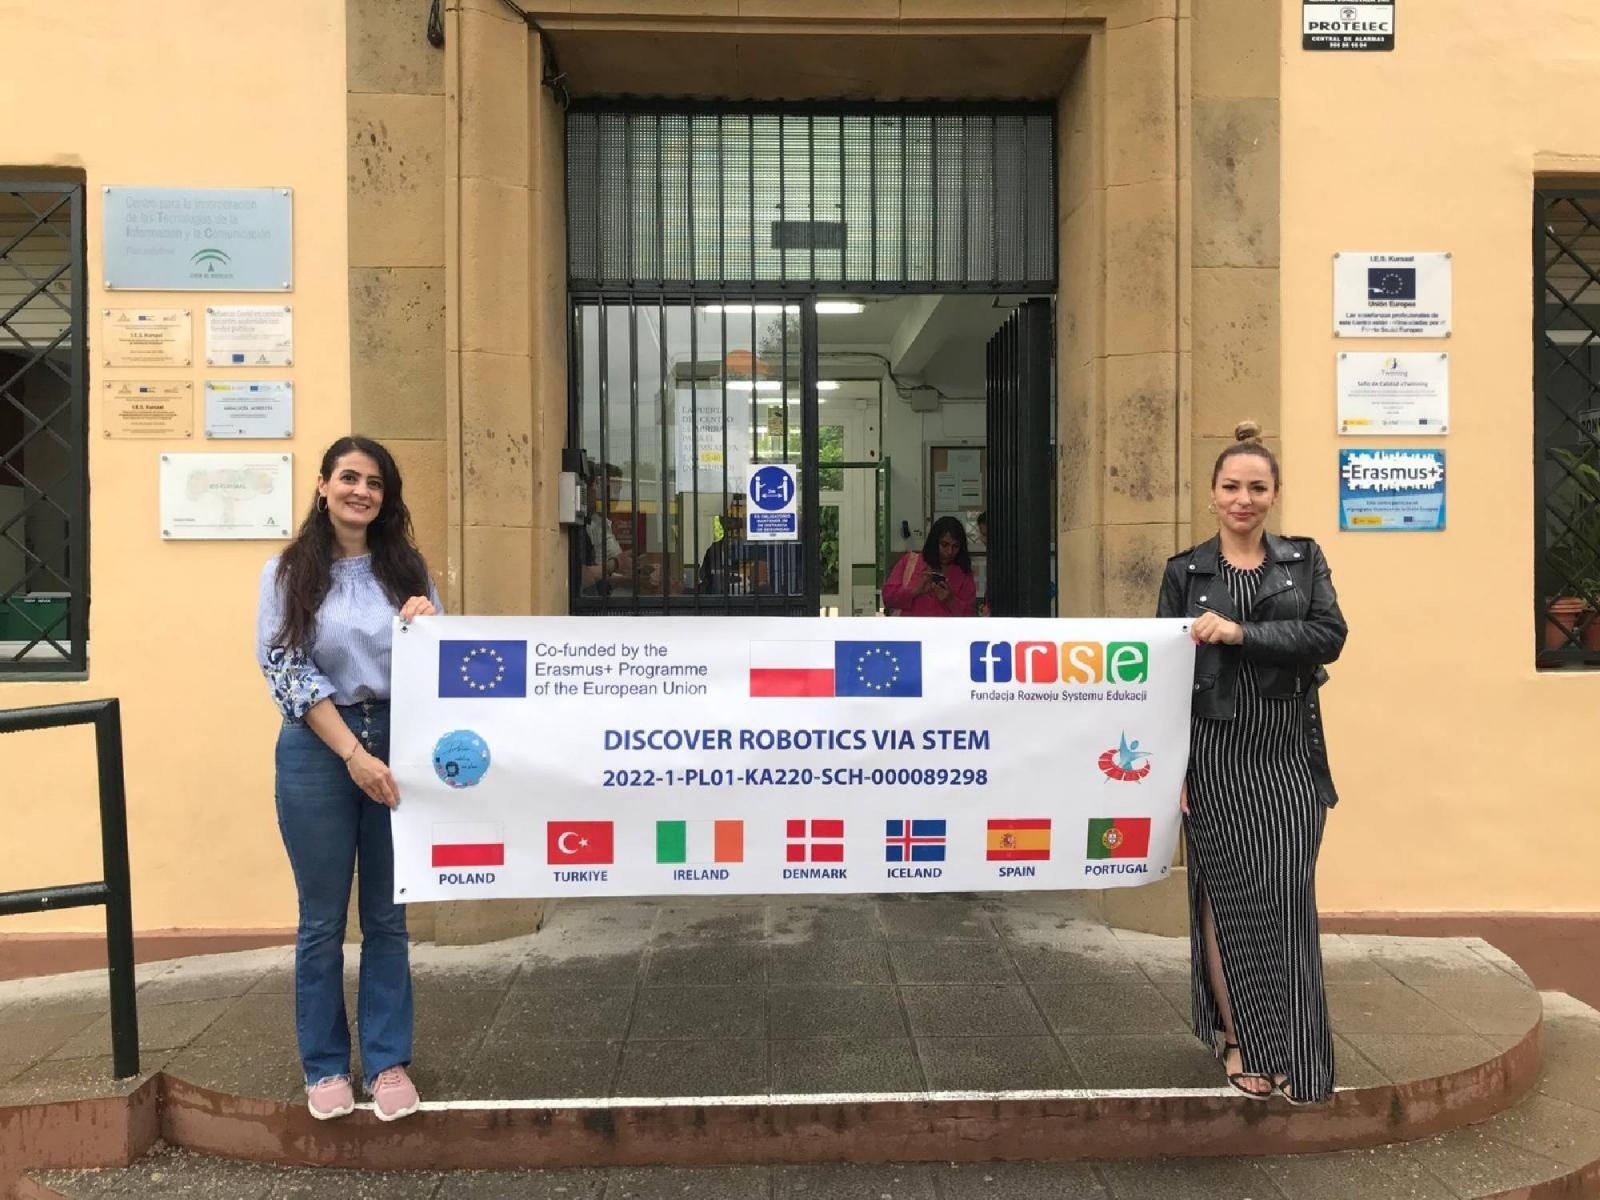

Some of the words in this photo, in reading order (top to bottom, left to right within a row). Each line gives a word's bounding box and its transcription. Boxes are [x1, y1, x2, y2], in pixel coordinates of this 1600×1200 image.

[1308, 21, 1389, 31] PROTELEC
[1351, 464, 1438, 480] Erasmus+
[535, 642, 618, 658] Co-funded
[621, 643, 639, 660] by
[642, 643, 668, 657] the
[976, 641, 1144, 684] frse
[535, 662, 613, 677] Erasmus+
[618, 661, 708, 680] Programme
[534, 682, 552, 696] of
[553, 682, 579, 696] the
[583, 681, 657, 698] European
[663, 681, 708, 696] Union
[970, 689, 1015, 702] Fundacja
[1017, 689, 1059, 702] Rozwoju
[1062, 690, 1103, 702] Systemu
[1106, 689, 1148, 702] Edukacji
[603, 729, 733, 752] DISCOVER
[739, 728, 867, 751] ROBOTICS
[872, 729, 916, 750] VIA
[922, 729, 991, 751] STEM
[602, 767, 989, 787] 2022-1-PL01-KA220-SCH-000089298
[673, 868, 730, 881] IRELAND
[782, 867, 848, 880] DENMARK
[886, 867, 943, 880] ICELAND
[998, 865, 1036, 878] SPAIN
[1084, 863, 1149, 876] PORTUGAL
[438, 872, 496, 885] POLAND
[553, 870, 608, 883] TURKIYE
